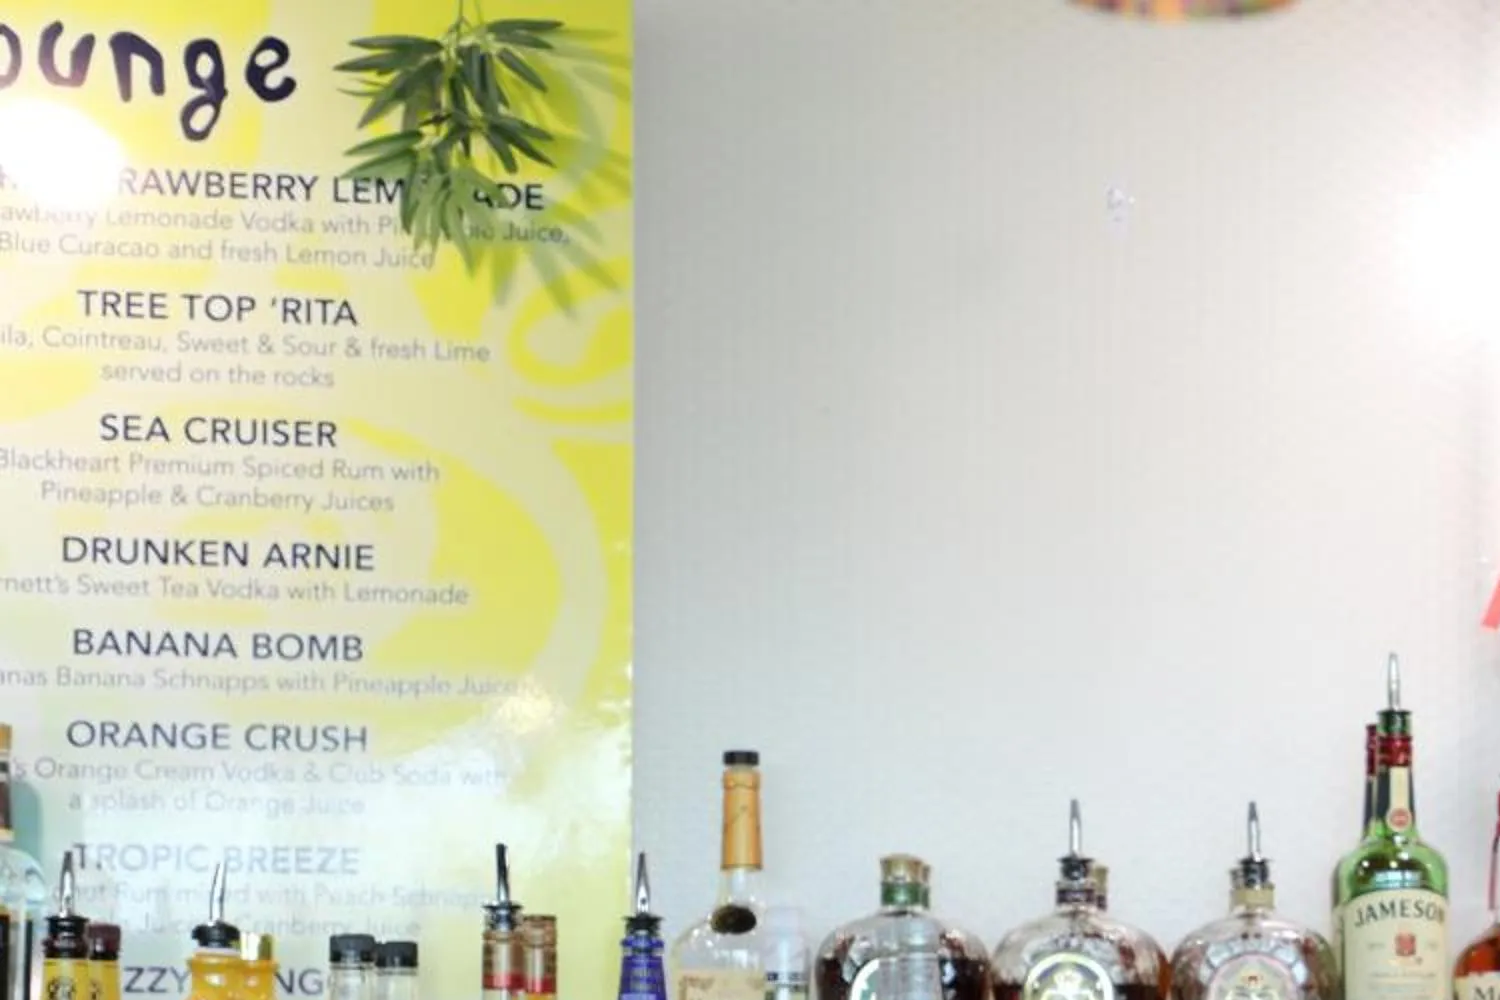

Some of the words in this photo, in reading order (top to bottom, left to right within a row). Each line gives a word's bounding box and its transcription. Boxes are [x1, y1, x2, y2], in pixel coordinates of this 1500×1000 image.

[118, 167, 320, 203] RAWBERRY
[333, 175, 545, 211] LEMADE
[106, 207, 235, 231] Lemonade
[240, 208, 315, 234] Vodka
[322, 214, 371, 236] with
[58, 233, 160, 258] Curacao
[167, 239, 214, 260] and
[221, 240, 278, 264] fresh
[286, 243, 367, 267] Lemon
[373, 247, 435, 269] Juice
[76, 289, 169, 320] TREE
[179, 292, 258, 322] TOP
[175, 329, 250, 354] Sweet
[257, 332, 276, 355] &
[281, 333, 338, 358] Sour
[343, 336, 363, 358] &
[370, 336, 427, 361] fresh
[434, 339, 491, 363] Lime
[101, 361, 182, 384] served
[189, 366, 219, 385] on
[228, 363, 266, 386] the
[273, 366, 336, 388] rocks
[99, 412, 171, 443] SEA
[183, 415, 339, 449] CRUISER
[129, 450, 235, 477] Premium
[243, 454, 325, 481] Spiced
[332, 457, 385, 482] Rum
[391, 458, 440, 483] with
[41, 479, 163, 508] Pineapple
[170, 483, 189, 506] &
[196, 484, 314, 514] Cranberry
[320, 488, 395, 513] Juices
[62, 535, 249, 568] DRUNKEN
[262, 541, 376, 572] ARNIE
[76, 573, 150, 598] Sweet
[159, 575, 199, 600] Tea
[205, 578, 280, 602] Vodka
[287, 579, 336, 603] with
[343, 581, 469, 606] Lemonade
[72, 628, 239, 661] BANANA
[251, 632, 364, 663] BOMB
[56, 664, 146, 690] Banana
[153, 667, 269, 697] Schnapps
[277, 670, 325, 693] with
[332, 671, 451, 699] Pineapple
[66, 719, 233, 751] ORANGE
[244, 722, 368, 754] CRUSH
[33, 756, 128, 785] Orange
[134, 758, 215, 782] Cream
[220, 760, 295, 784] Vodka
[303, 763, 321, 783] &
[72, 843, 210, 873] TROPIC
[224, 845, 360, 876] BREEZE
